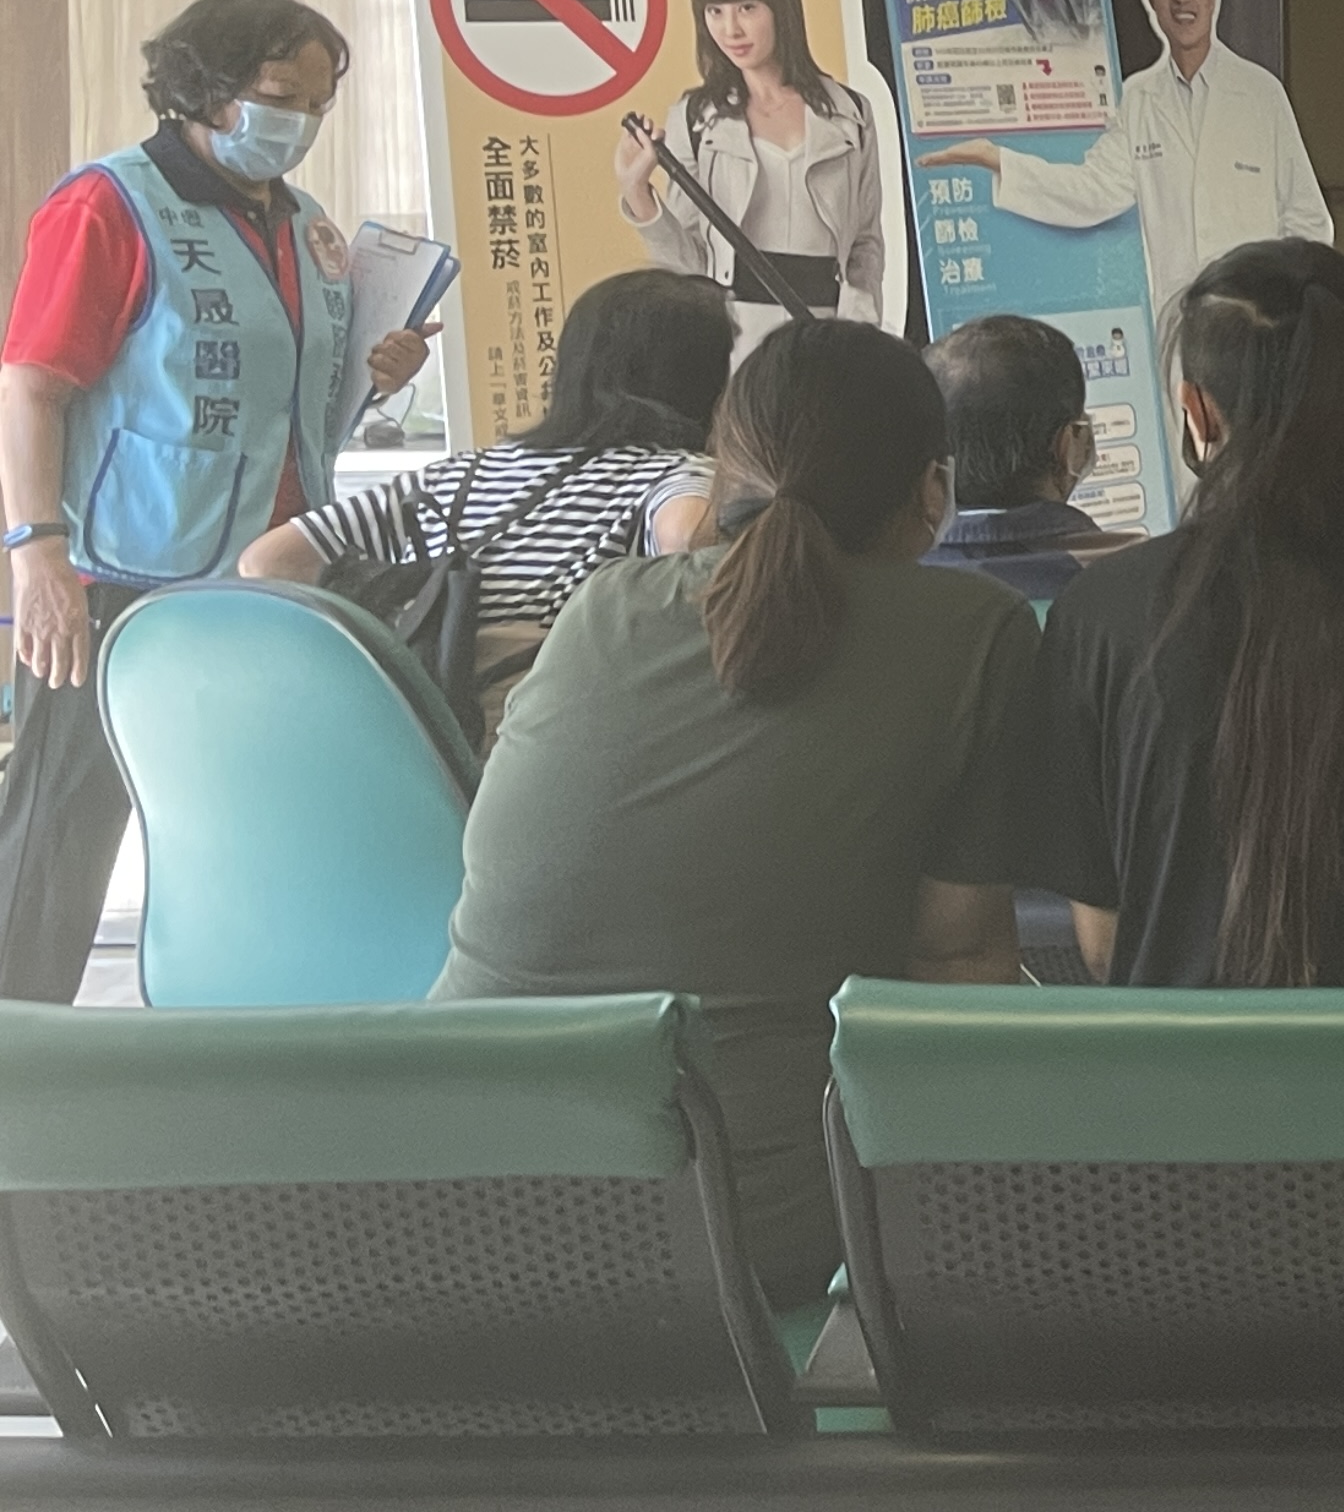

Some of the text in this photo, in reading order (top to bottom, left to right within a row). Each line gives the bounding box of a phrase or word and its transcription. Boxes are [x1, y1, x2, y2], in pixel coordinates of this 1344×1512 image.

[482, 136, 521, 270] 全面禁菸
[928, 176, 974, 205] 預防
[169, 237, 241, 437] 天晟醫院
[519, 134, 557, 416] 大多數的室內工作及公
[939, 256, 985, 285] 治療
